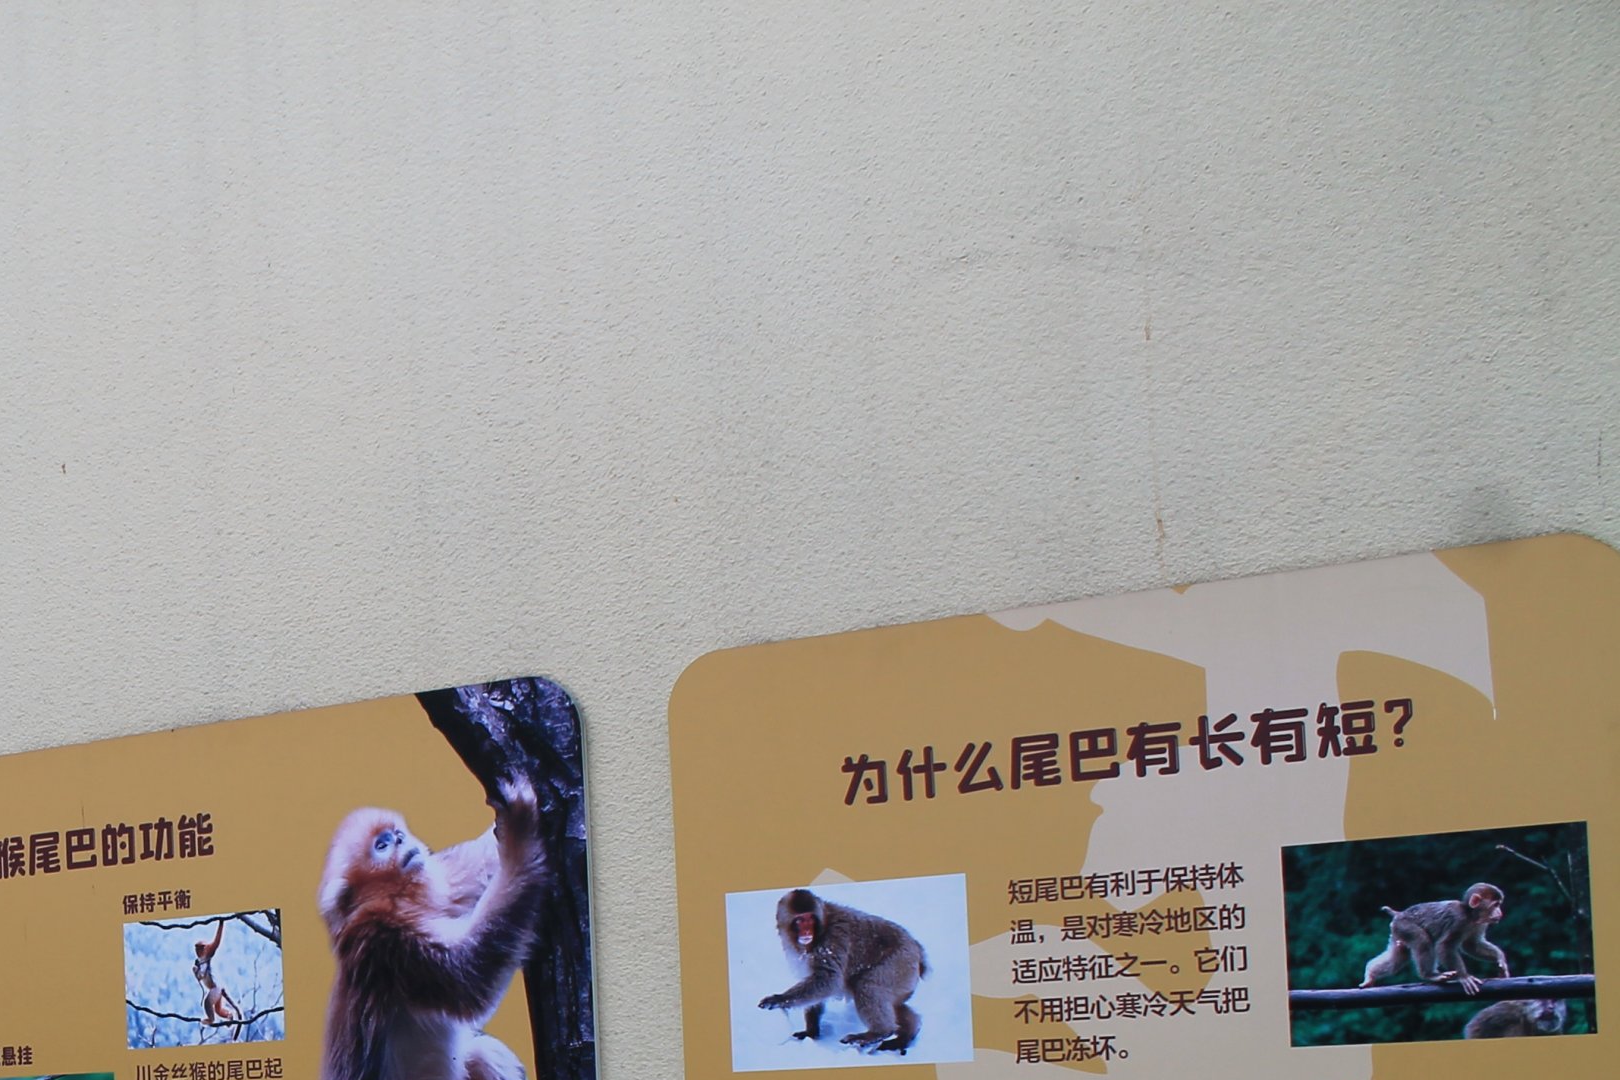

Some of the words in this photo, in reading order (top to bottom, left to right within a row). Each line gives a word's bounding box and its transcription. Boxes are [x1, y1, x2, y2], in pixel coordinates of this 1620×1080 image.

[841, 697, 1413, 806] 为什么尾巴有长有短？
[122, 889, 191, 915] 保持平衡
[1007, 861, 1244, 905] 短尾巴有利于保持体
[1010, 903, 1246, 945] 温，是对寒冷地区的
[1011, 946, 1248, 986] 适应特征之一。它们
[1013, 987, 1250, 1025] 不用担心寒冷天气把
[1015, 1036, 1130, 1064] 尾巴冻坏。
